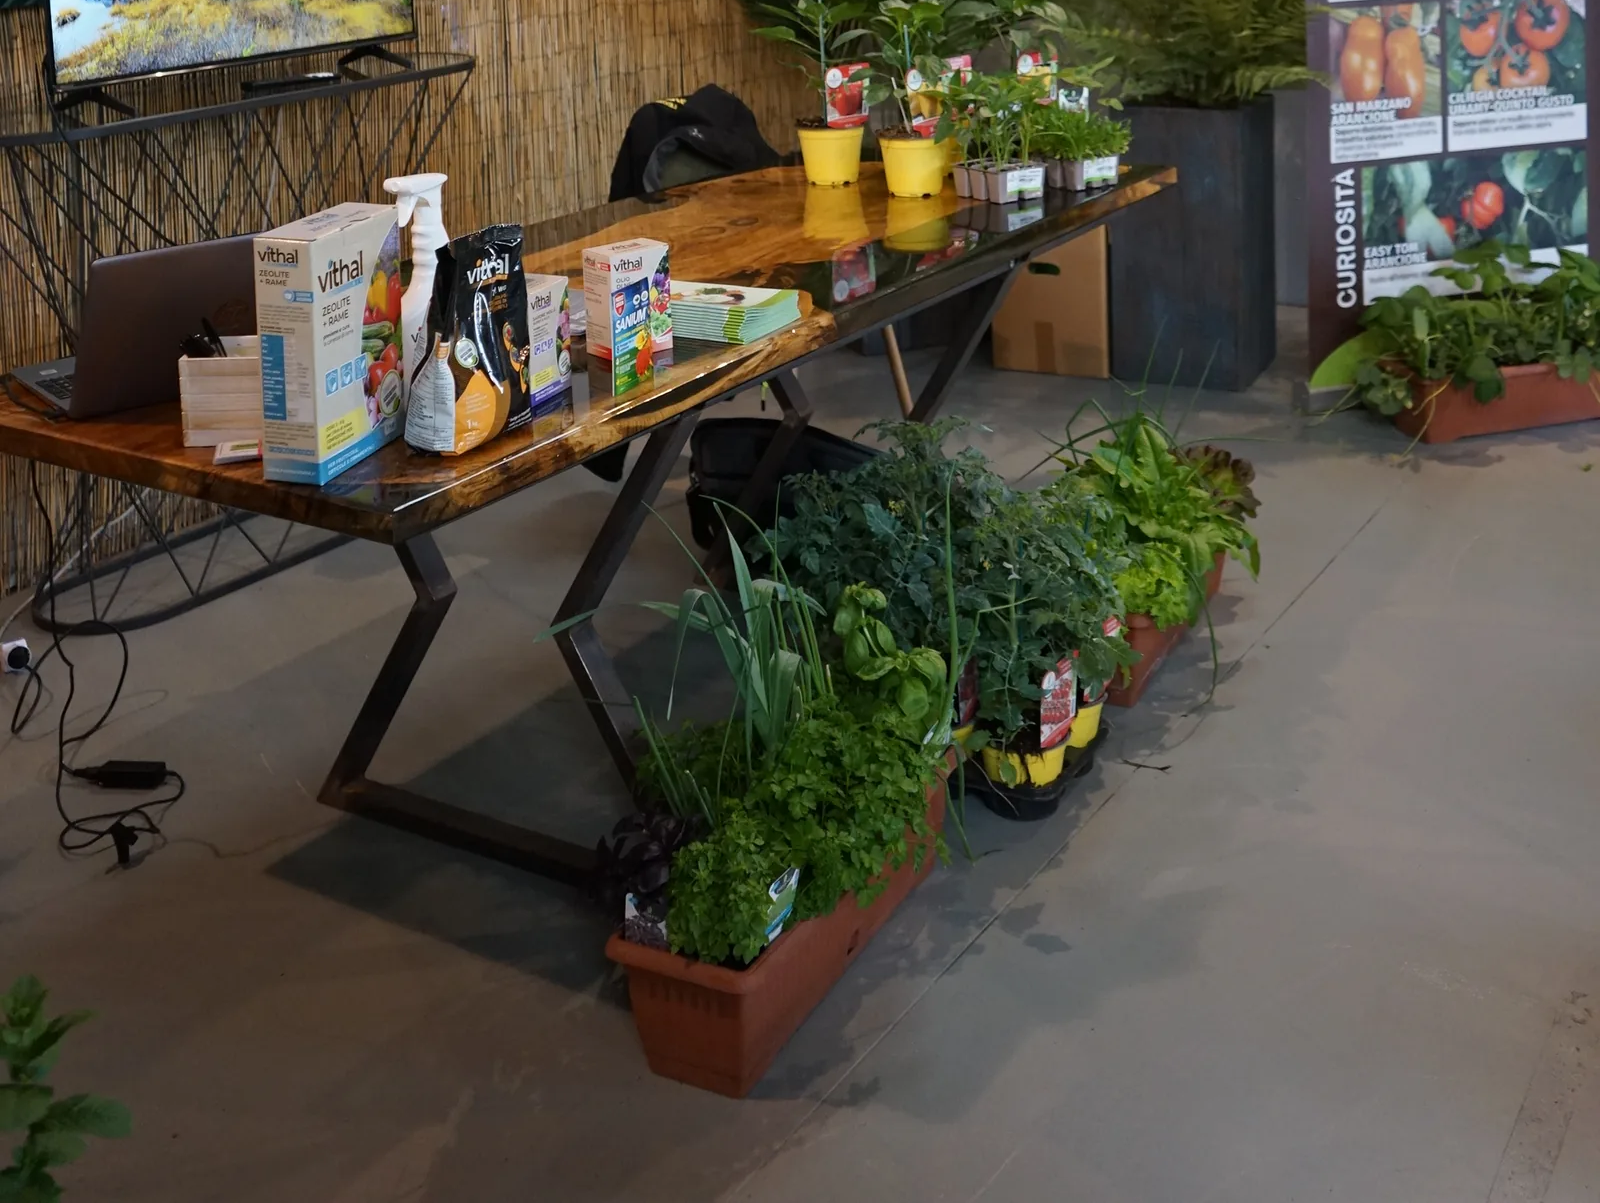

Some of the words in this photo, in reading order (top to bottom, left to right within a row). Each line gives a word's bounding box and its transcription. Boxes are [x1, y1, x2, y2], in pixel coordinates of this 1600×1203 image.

[1330, 101, 1354, 116] SAN
[1355, 96, 1412, 113] MARZANO
[1448, 90, 1494, 105] CILIEGIA
[1537, 93, 1575, 109] GUSTO
[1330, 108, 1398, 127] ARANCIONE
[1331, 168, 1358, 309] CURIOSITÀ
[257, 246, 298, 264] vithal
[1364, 245, 1394, 259] EASY
[1395, 242, 1419, 256] TOM
[613, 256, 643, 272] vithal
[1364, 252, 1428, 270] ARANCIONE
[259, 269, 290, 279] ZEOLITE
[318, 250, 363, 293] vithal
[616, 276, 631, 284] OLIO
[265, 278, 287, 287] RAME
[322, 295, 351, 317] ZEOLITE
[530, 291, 552, 310] vithal
[328, 309, 349, 327] RAME
[615, 306, 647, 334] SANIUM
